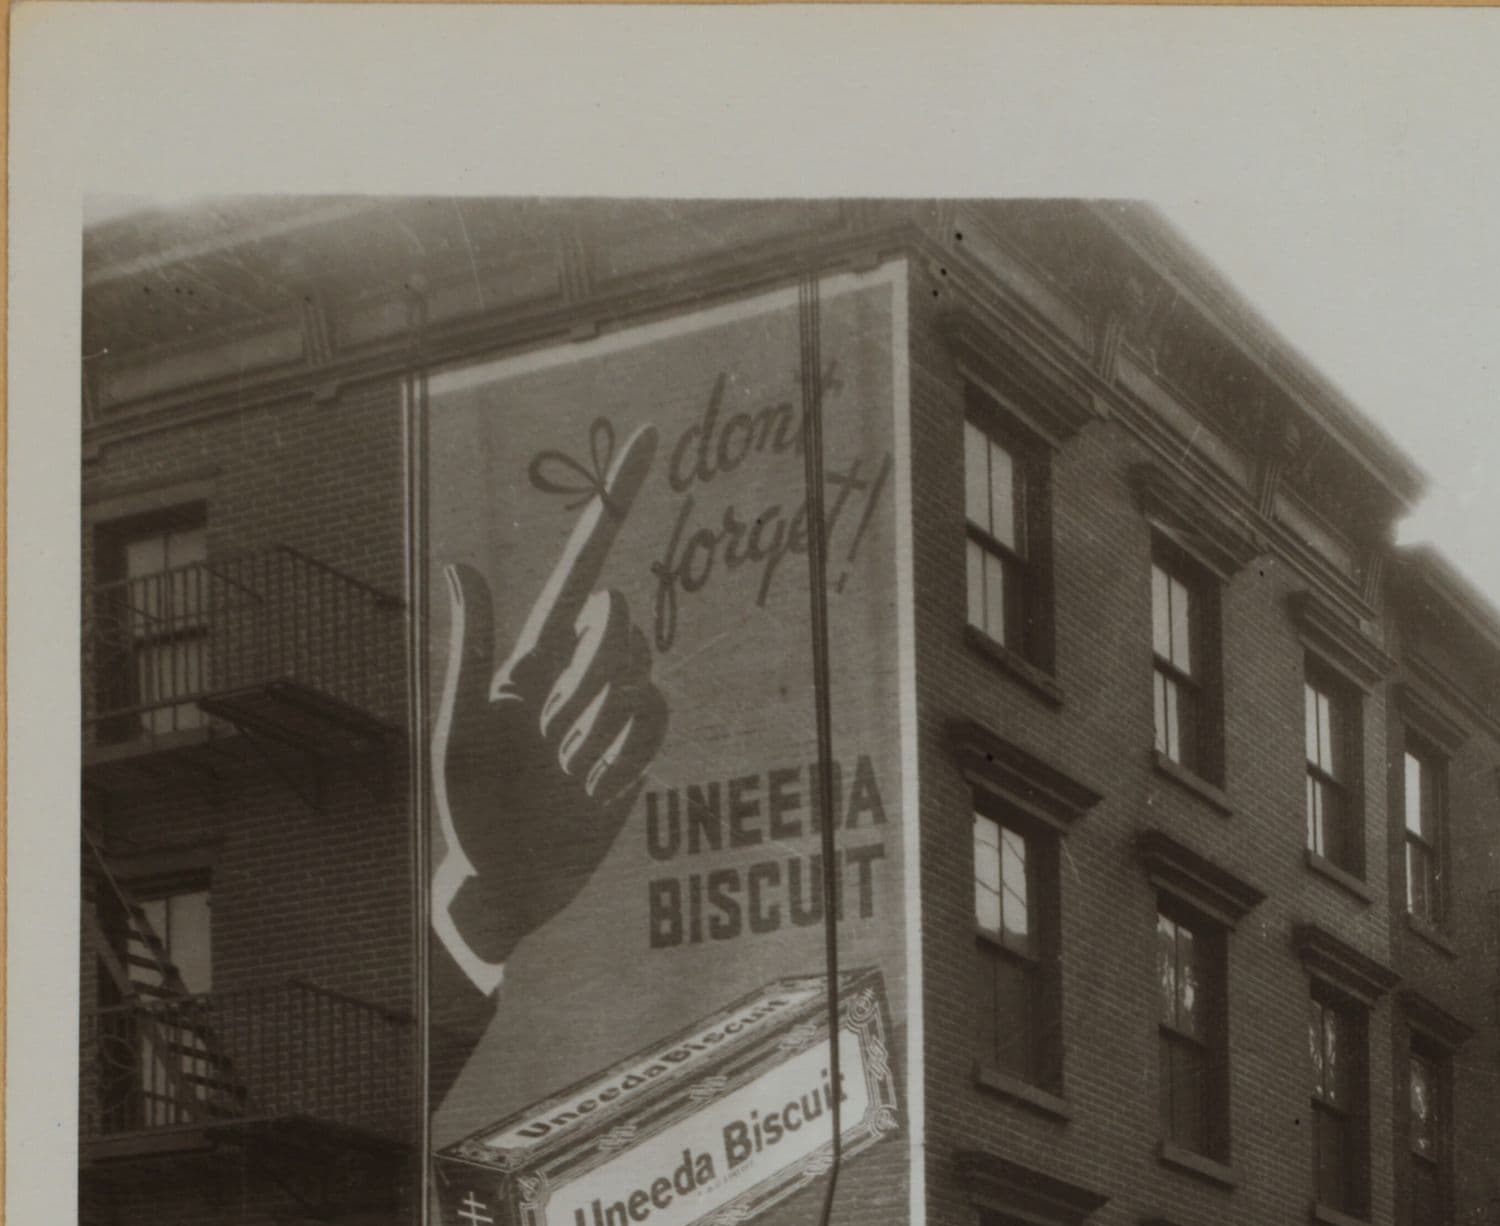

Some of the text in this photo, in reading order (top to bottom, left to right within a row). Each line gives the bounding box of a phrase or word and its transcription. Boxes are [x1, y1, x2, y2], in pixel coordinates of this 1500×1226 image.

[646, 755, 888, 861] UNEEDA
[650, 843, 886, 949] BISCUIT
[518, 997, 791, 1140] Uneeda Biscuit
